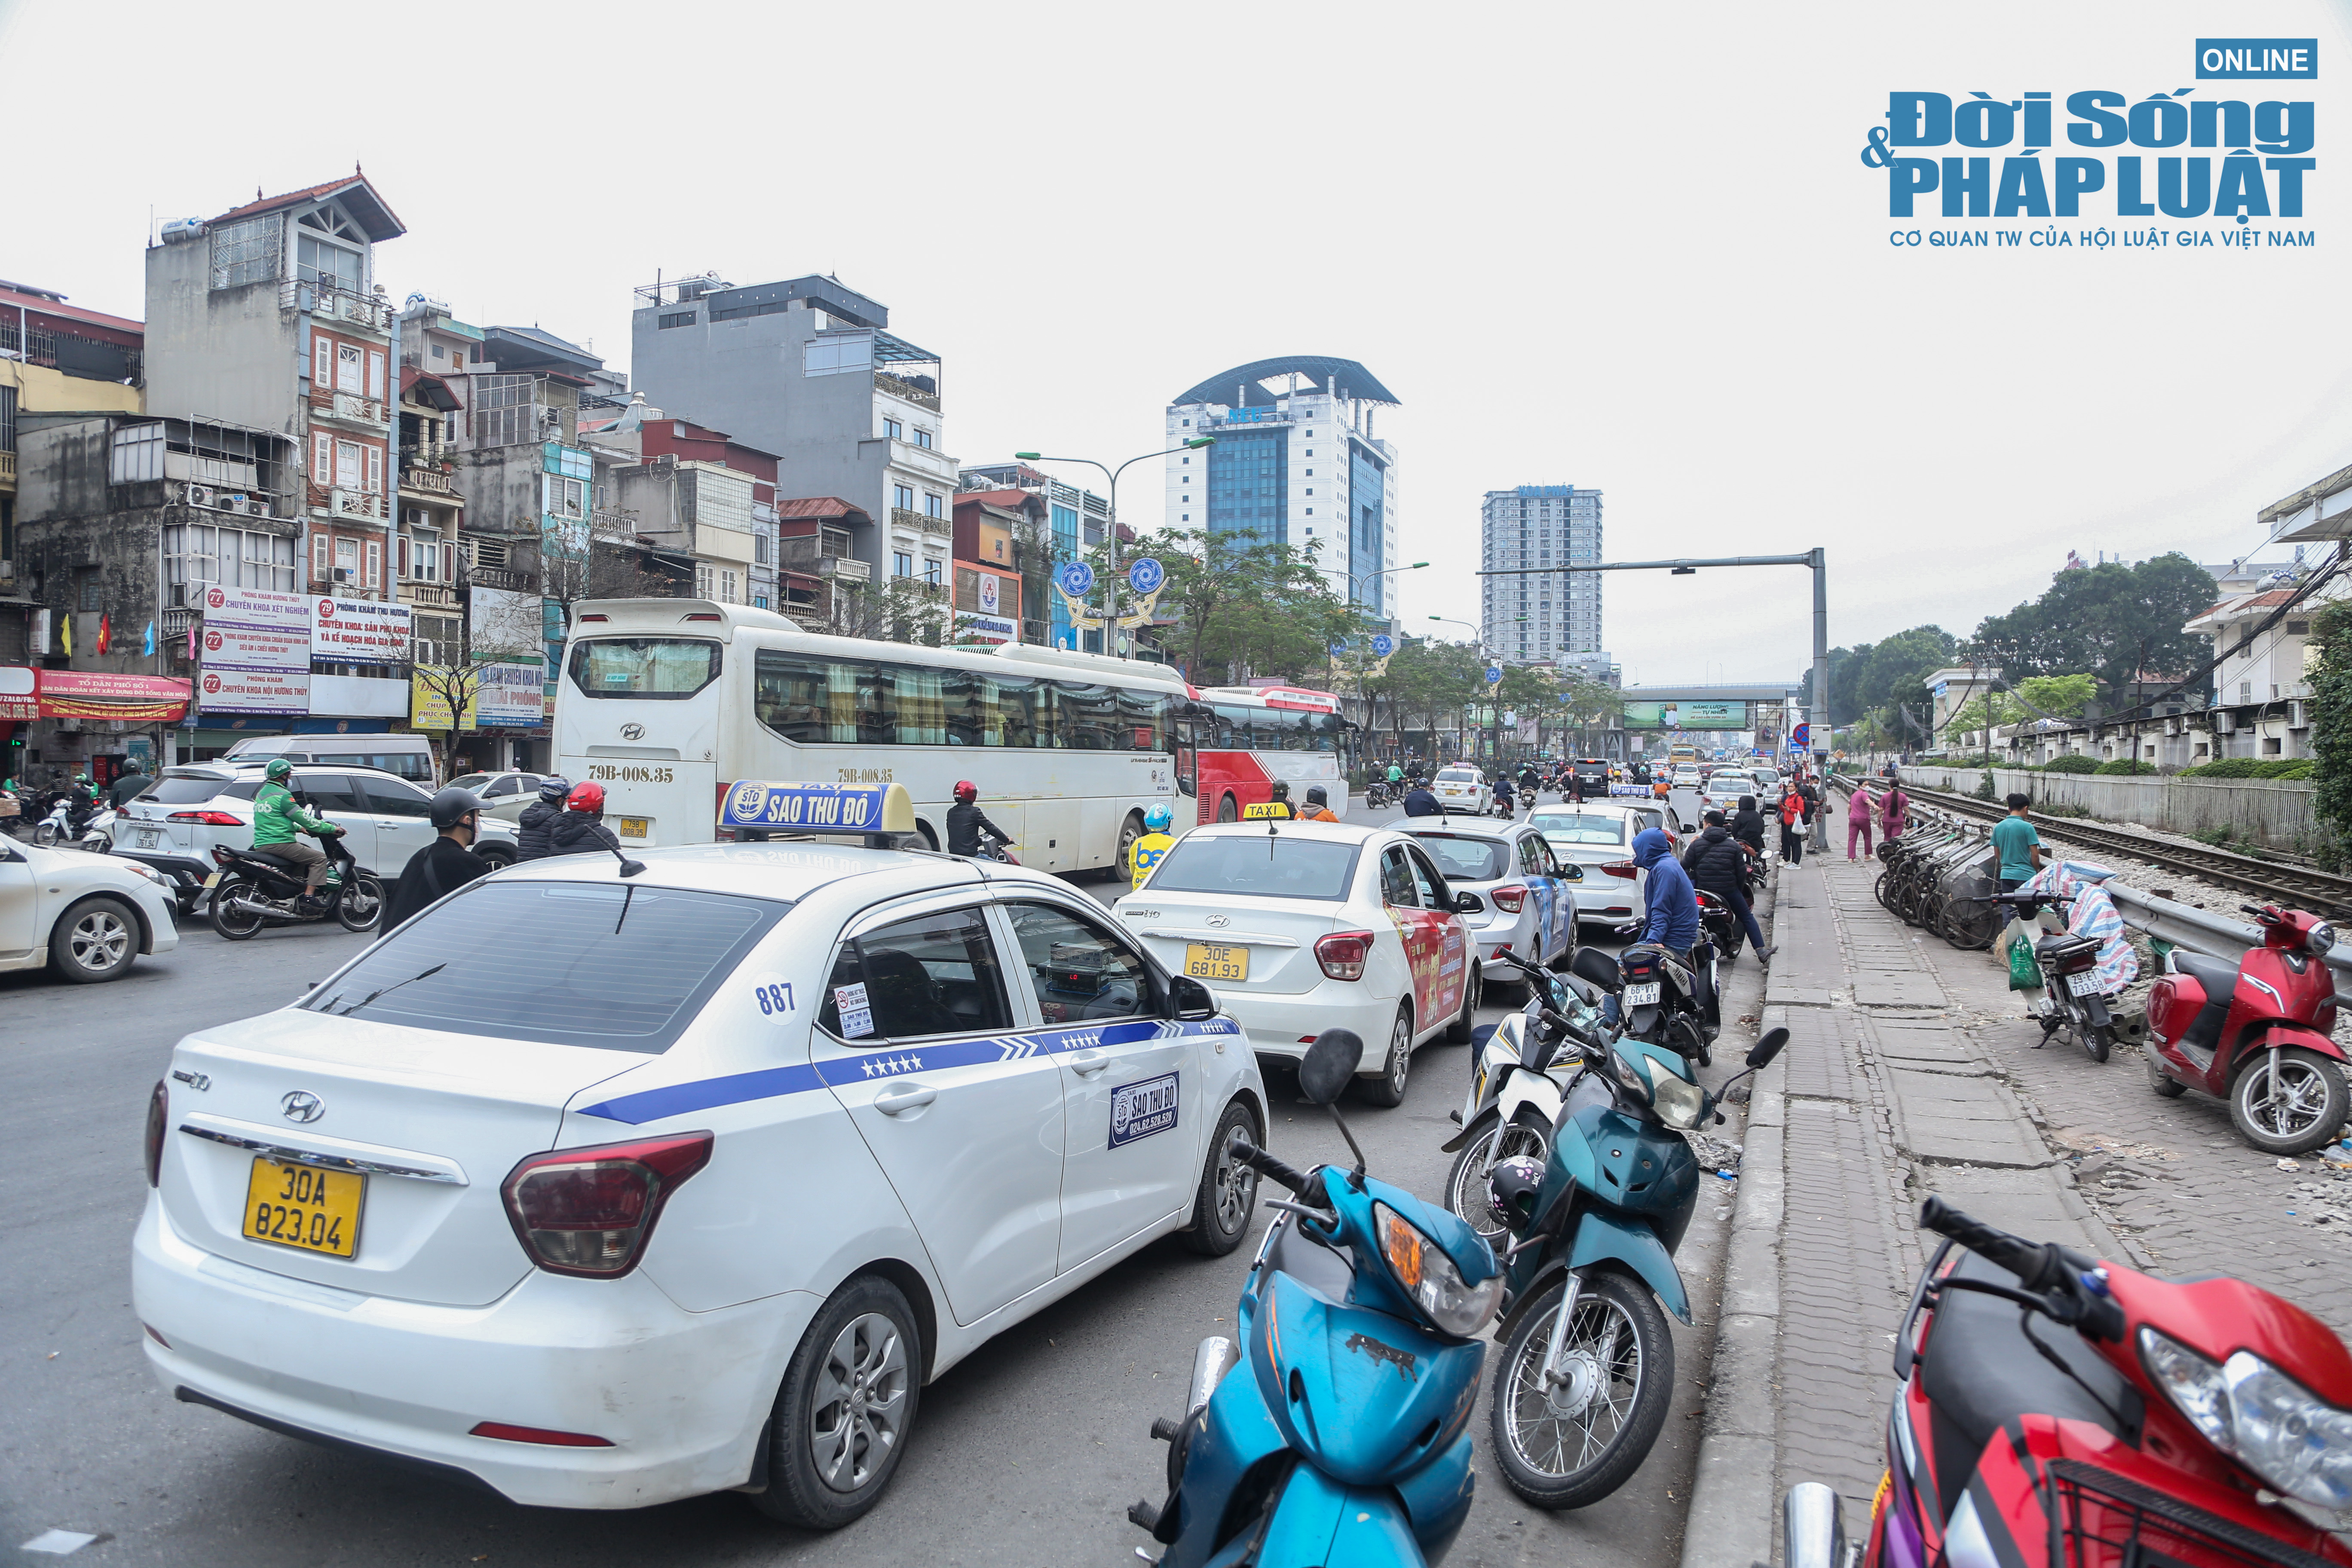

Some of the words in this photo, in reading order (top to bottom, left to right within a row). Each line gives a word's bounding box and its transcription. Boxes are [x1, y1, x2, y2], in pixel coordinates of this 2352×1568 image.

[1228, 407, 1262, 424] NEU
[210, 592, 222, 602] 77
[226, 600, 251, 610] CHUYÊN
[253, 603, 270, 612] KHOA
[272, 604, 283, 613] XÉT
[285, 606, 309, 616] NGHIỆM
[321, 603, 332, 612] 79
[337, 602, 357, 612] PHÒNG
[358, 604, 376, 614] KHÁM
[378, 607, 388, 615] THU
[318, 619, 343, 629] CHUYÊN
[365, 621, 378, 632] SẢN
[393, 625, 409, 635] KHOA
[1000, 623, 1013, 634] KHOA
[207, 634, 220, 644] 77
[342, 634, 362, 645] HOẠCH
[205, 677, 218, 687] 77
[505, 665, 521, 686] CHUYÊN
[523, 669, 534, 686] KHOA
[222, 684, 245, 693] CHUYÊN
[246, 686, 261, 694] KHOA
[263, 685, 273, 696] NỘI
[274, 686, 292, 695] HƯƠNG
[511, 689, 542, 706] PHÓNG
[588, 764, 674, 783] 79B-008.35
[838, 768, 893, 783] 79B-008.35
[1631, 785, 1639, 794] THỦ
[767, 794, 803, 823] SAO
[807, 790, 840, 824] THỦ
[843, 792, 868, 825] ĐÔ
[1250, 805, 1277, 816] TAXI
[623, 827, 643, 836] 008.35
[1136, 842, 1166, 869] be
[1204, 946, 1231, 962] 30E
[1191, 961, 1240, 978] 681.93
[1675, 967, 1689, 988] YAMAHA
[2072, 971, 2097, 985] 29-E1
[1631, 984, 1654, 995] 66-V1
[2072, 980, 2104, 995] 733.58
[756, 982, 796, 1015] 887
[854, 996, 867, 1004] SMOKING
[1626, 993, 1657, 1004] 234.81
[1132, 1096, 1147, 1118] SAO
[1148, 1082, 1163, 1113] THỦ
[1164, 1081, 1174, 1108] ĐÔ
[1129, 1111, 1173, 1135] 024.62.528.528
[279, 1167, 326, 1207] 30A
[255, 1202, 342, 1250] 823.04
